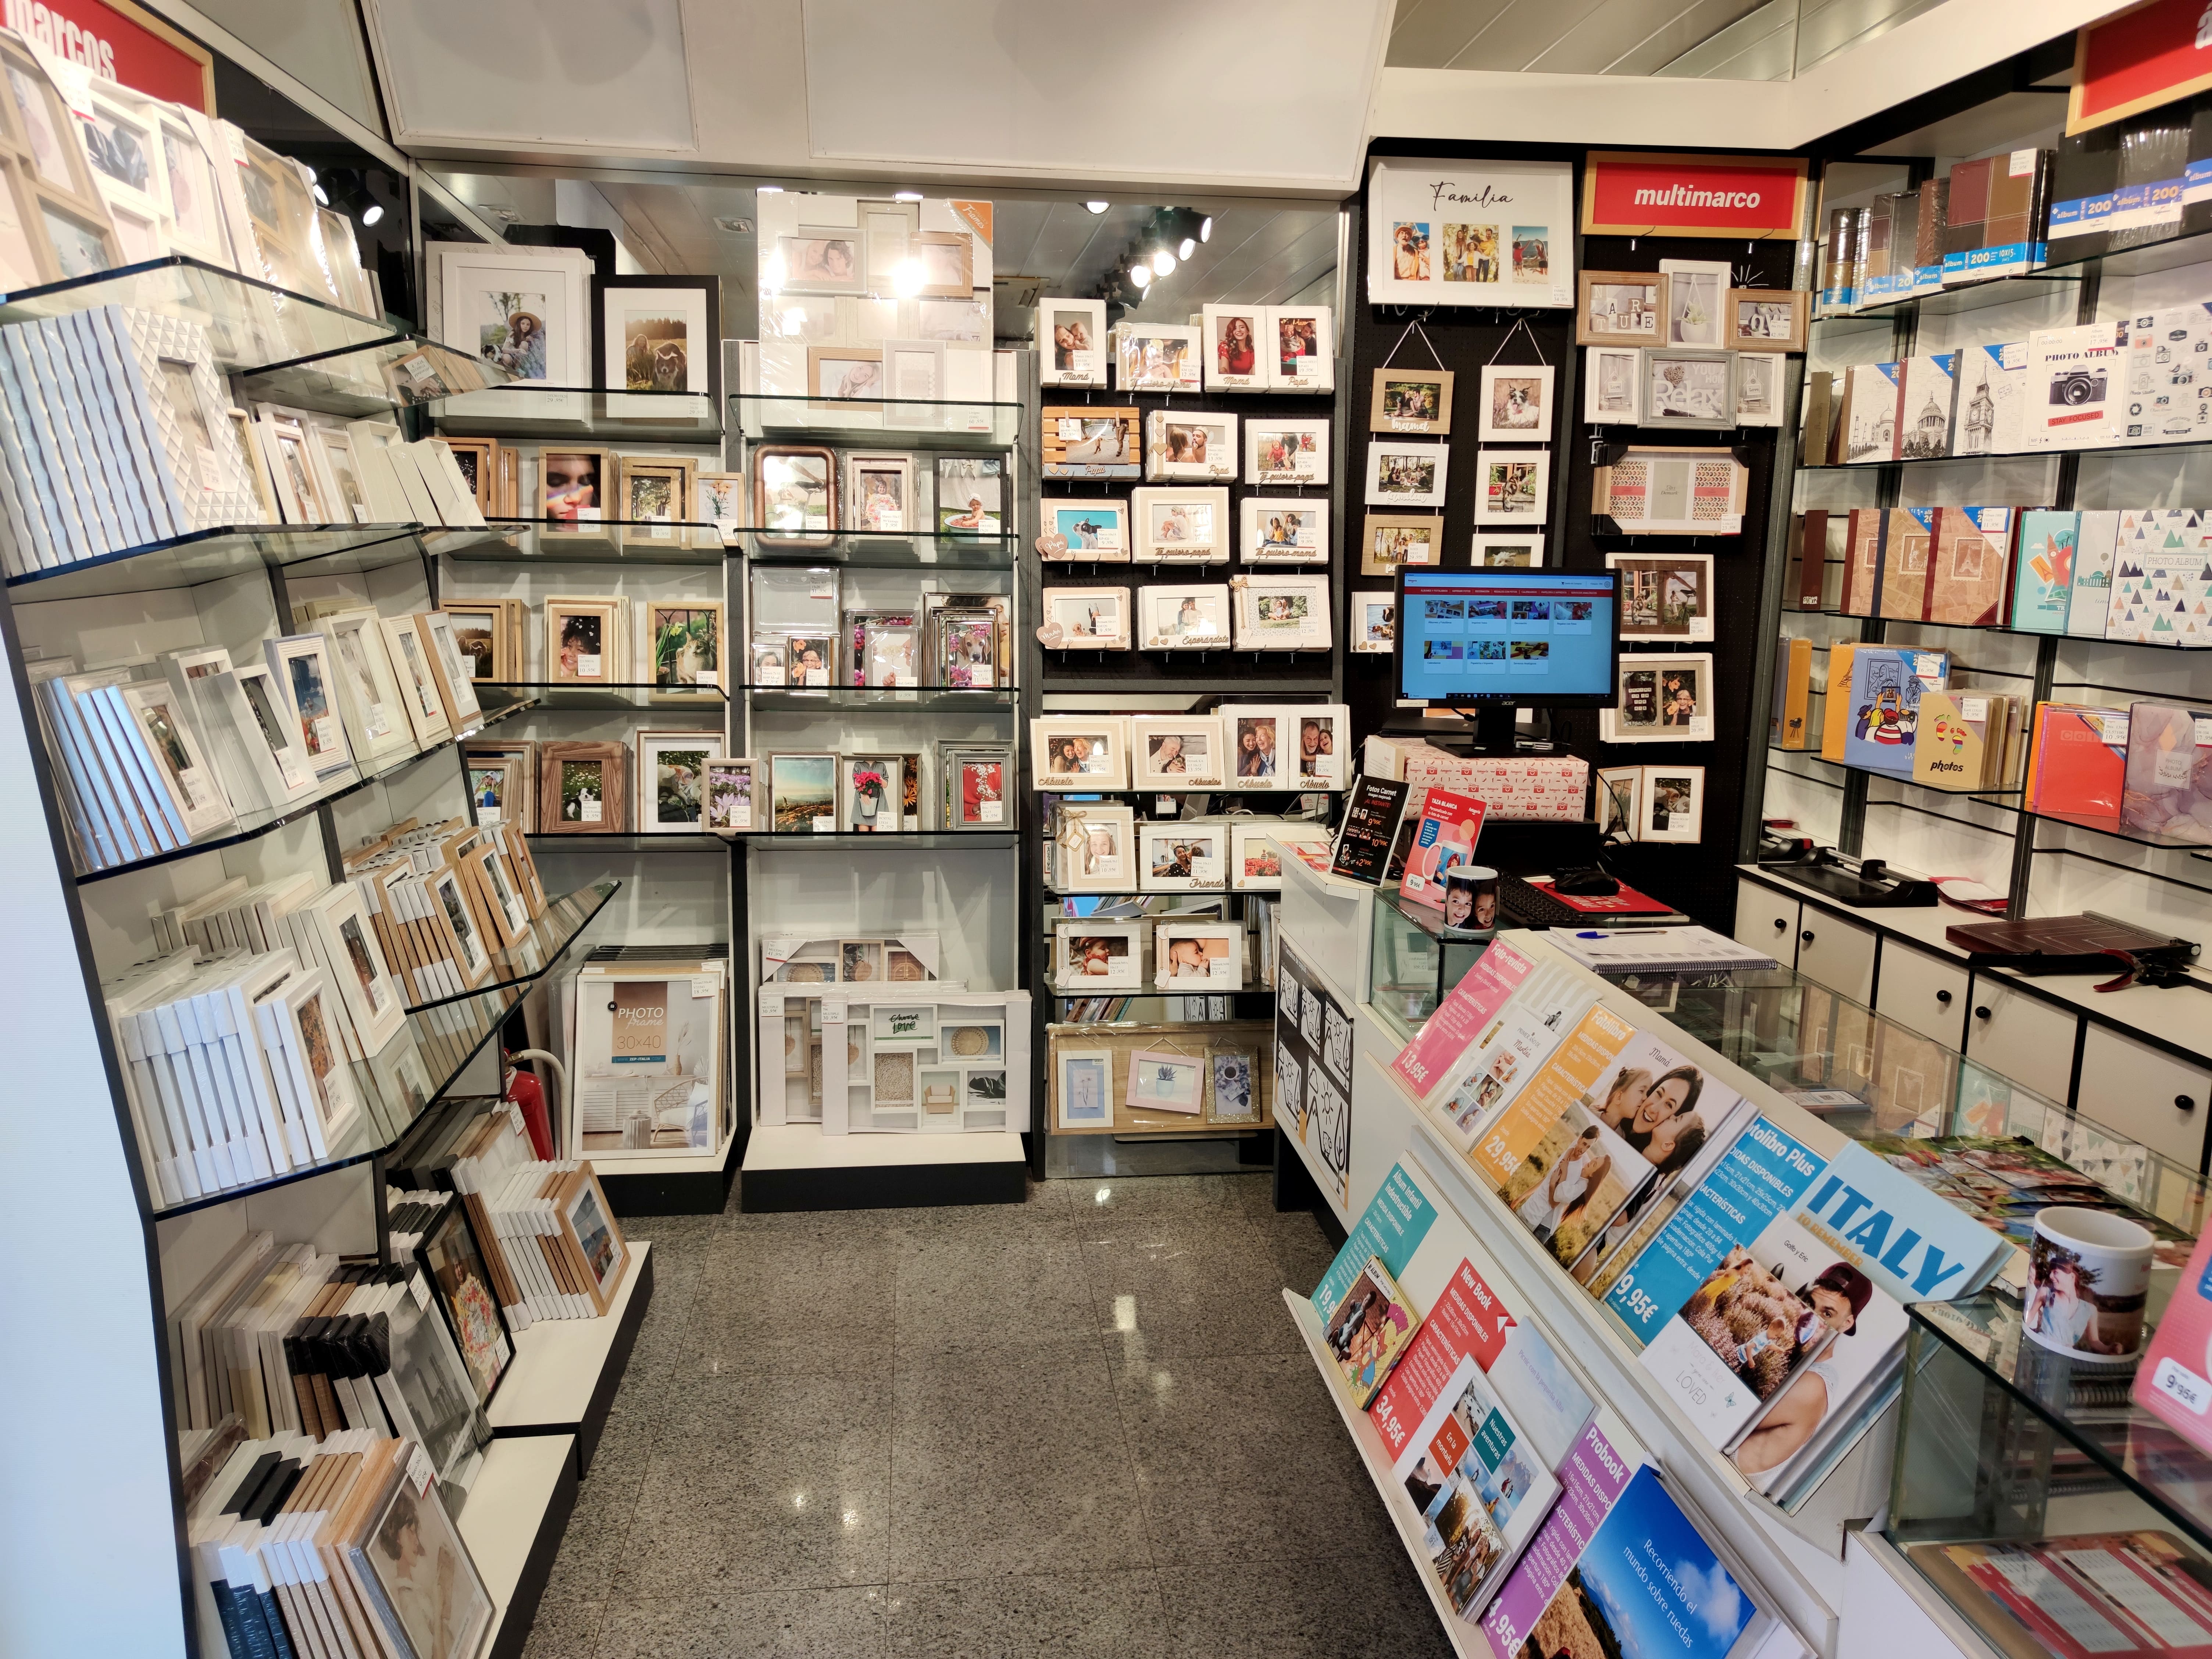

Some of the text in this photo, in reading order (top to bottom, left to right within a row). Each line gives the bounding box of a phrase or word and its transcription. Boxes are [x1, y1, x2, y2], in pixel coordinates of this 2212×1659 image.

[1430, 181, 1513, 211] Familia
[1634, 185, 1760, 208] multimarco
[2117, 186, 2179, 206] album 200
[2057, 200, 2112, 219] album 200
[1970, 252, 1990, 264] 200
[2045, 349, 2119, 362] PHOTO ALBUM
[1062, 372, 1089, 381] Mamá
[1223, 377, 1250, 385] Mamá
[1288, 377, 1309, 387] Papá
[2051, 412, 2099, 425] STAY FOCUSED
[1085, 465, 1106, 475] Papá
[1208, 465, 1230, 475] Papá
[1270, 473, 1293, 482] quiero
[1294, 473, 1314, 482] papá
[1045, 539, 1064, 550] Papá
[1166, 549, 1189, 558] quiero
[1190, 548, 1211, 557] papá
[1265, 549, 1291, 558] quiero
[1291, 549, 1317, 557] mamá
[2147, 557, 2203, 566] PHOTO ALBUM
[1040, 628, 1061, 640] Mamá
[1182, 635, 1229, 646] Esperándote
[1930, 760, 1964, 772] photos
[1038, 777, 1074, 786] Abuela
[1188, 778, 1222, 786] Abuelos
[1238, 779, 1273, 788] Abuela
[1300, 779, 1330, 789] Abuelo
[1366, 785, 1397, 796] Fotos Carnet
[1429, 806, 1447, 816] Personalizada
[1431, 798, 1458, 810] TAZA BLANCA
[1189, 878, 1225, 888] Friends
[1491, 943, 1527, 974] Foto-revista
[1479, 961, 1517, 993] MEDIDAS DISPONIBLES
[1458, 988, 1487, 1015] CARACTERÍSTICAS
[618, 1007, 664, 1018] PHOTO
[626, 1016, 664, 1030] frame
[1591, 1010, 1627, 1041] Fotolibro
[617, 1035, 661, 1050] 30x40
[1517, 1027, 1530, 1039] PRIMER
[1529, 1036, 1537, 1045] AÑO
[1577, 1031, 1599, 1052] MEDIDAS
[1513, 1039, 1531, 1058] Martina
[1649, 1047, 1673, 1067] Mamá
[1401, 1050, 1429, 1083] 13,95€
[1784, 1148, 1816, 1177] Plus
[1747, 1159, 1794, 1198] DISPONIBLES
[1392, 1169, 1423, 1210] Álbum Infantil
[1385, 1182, 1413, 1221] Indestructible
[1376, 1197, 1405, 1237] MEDIDA DISPONIBLE
[1364, 1217, 1389, 1253] CARACTERÍSTICAS
[1797, 1212, 1864, 1267] TO REMEMBER
[1806, 1174, 1965, 1297] ITALY
[1784, 1239, 1796, 1252] Golfo
[1798, 1252, 1809, 1263] Eric
[1460, 1266, 1492, 1311] New Book
[1449, 1287, 1489, 1343] MEDIDAS DISPONIBLES
[1429, 1319, 1460, 1366] CARACTERÍSTICAS
[1517, 1349, 1565, 1413] Picnic con la pequeña Alba
[1676, 1369, 1707, 1405] LOVED
[1376, 1394, 1406, 1448] 34,95€
[1446, 1431, 1457, 1450] En la
[1489, 1418, 1508, 1447] Nuestras
[1435, 1439, 1453, 1466] montaña
[1481, 1429, 1501, 1460] aventuras
[1585, 1426, 1624, 1484] Probook
[1571, 1452, 1596, 1488] MEDIDAS
[1643, 1538, 1698, 1615] Recorriendo el
[1623, 1545, 1693, 1649] mundo sobre ruedas
